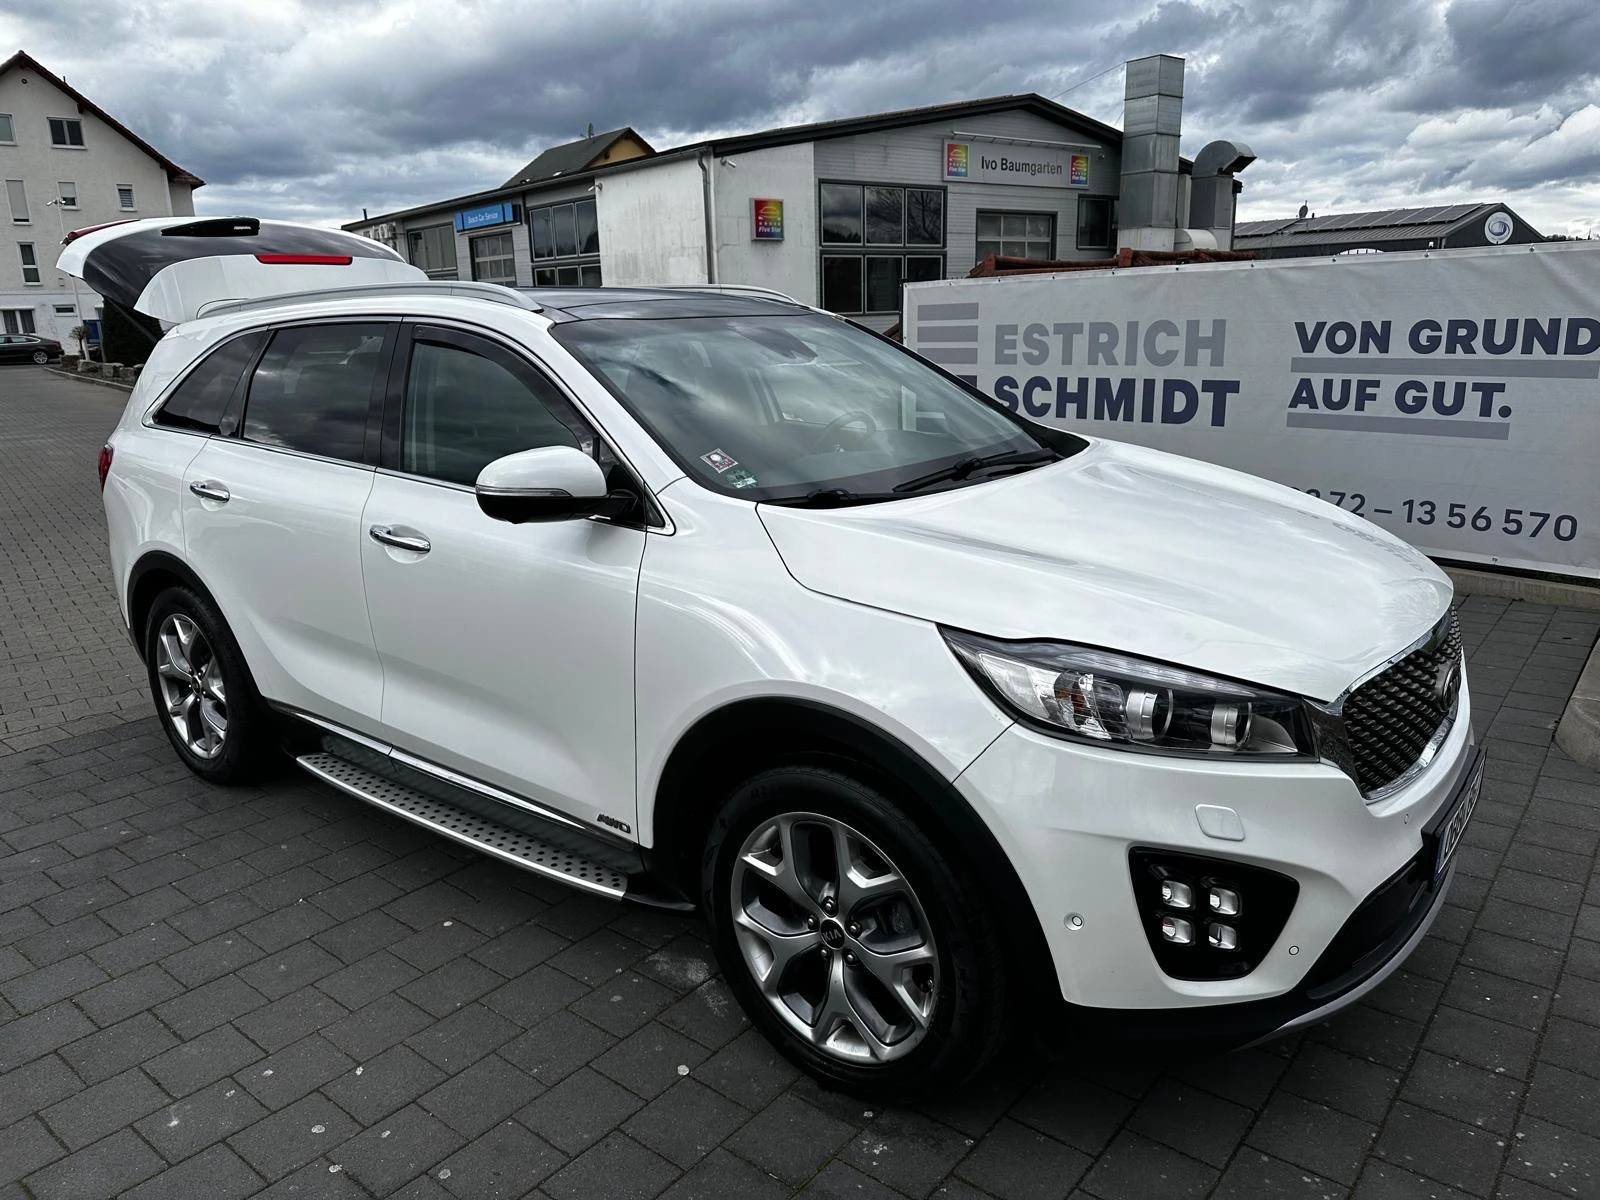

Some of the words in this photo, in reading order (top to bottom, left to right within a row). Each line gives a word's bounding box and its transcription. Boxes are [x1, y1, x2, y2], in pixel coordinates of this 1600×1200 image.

[981, 156, 997, 170] Ivo
[1001, 158, 1062, 176] Baumgarten
[995, 319, 1226, 367] ESTRICH
[1294, 321, 1392, 354] VON
[1408, 317, 1600, 355] GRUND
[994, 375, 1241, 427] SCHMIDT
[1288, 377, 1381, 411] AUF
[1394, 379, 1513, 418] GUT.
[1402, 499, 1436, 525] 13
[1446, 503, 1492, 532] 56
[1502, 509, 1578, 542] 570
[597, 813, 631, 834] AWD
